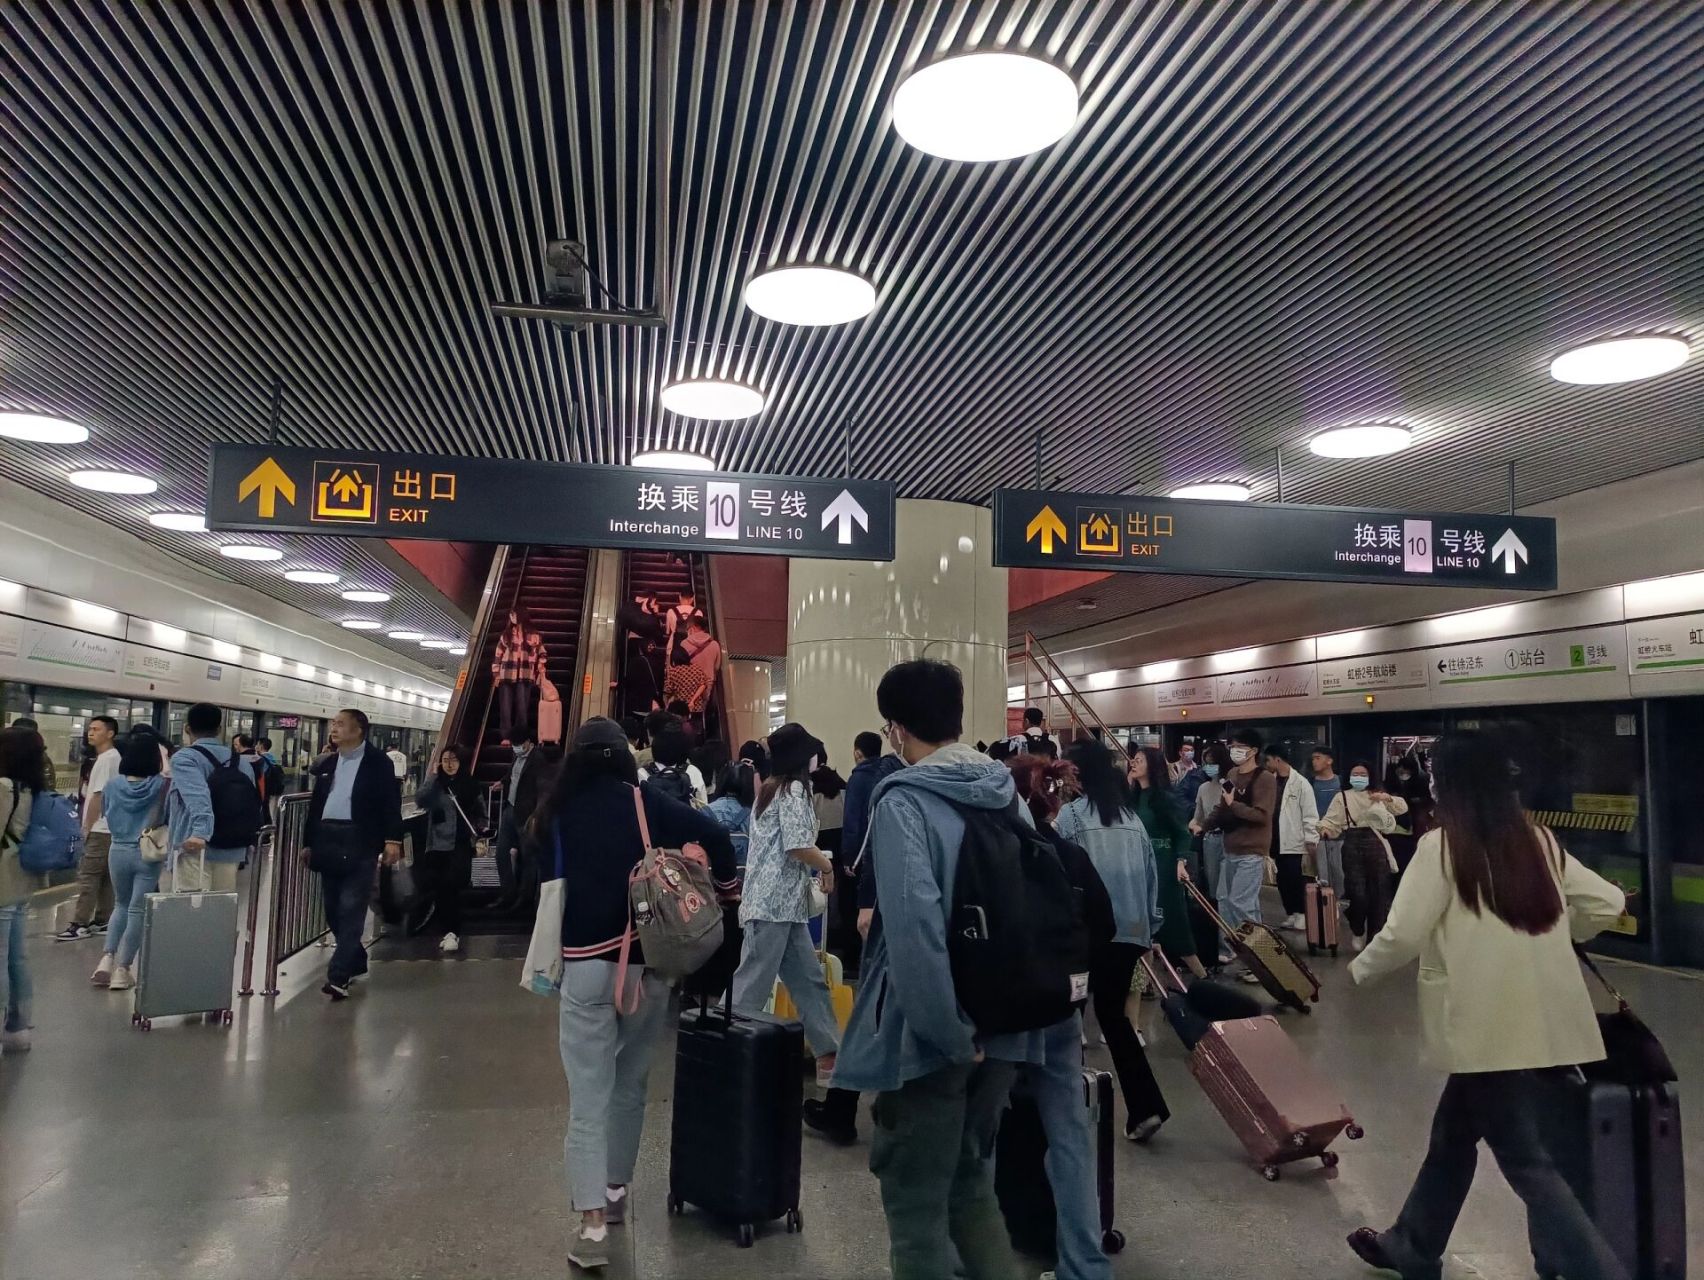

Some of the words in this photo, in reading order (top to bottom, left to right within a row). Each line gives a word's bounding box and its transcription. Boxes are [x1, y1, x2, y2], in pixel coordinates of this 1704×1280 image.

[393, 469, 456, 501] 出口
[637, 482, 700, 513] 换乘
[709, 493, 736, 528] 10
[747, 489, 808, 519] 号线
[389, 508, 429, 522] EXIT
[609, 519, 699, 538] Interchange
[1127, 511, 1173, 537] 出口
[746, 525, 782, 539] LINE
[786, 527, 803, 541] 10
[1353, 522, 1402, 549] 换乘
[1407, 536, 1427, 556] 10
[1439, 529, 1486, 555] 号线
[1131, 543, 1161, 556] EXIT
[1335, 550, 1401, 566] Interchange
[1436, 556, 1464, 568] LINE
[1467, 557, 1480, 568] 10
[1587, 644, 1608, 659] 号线
